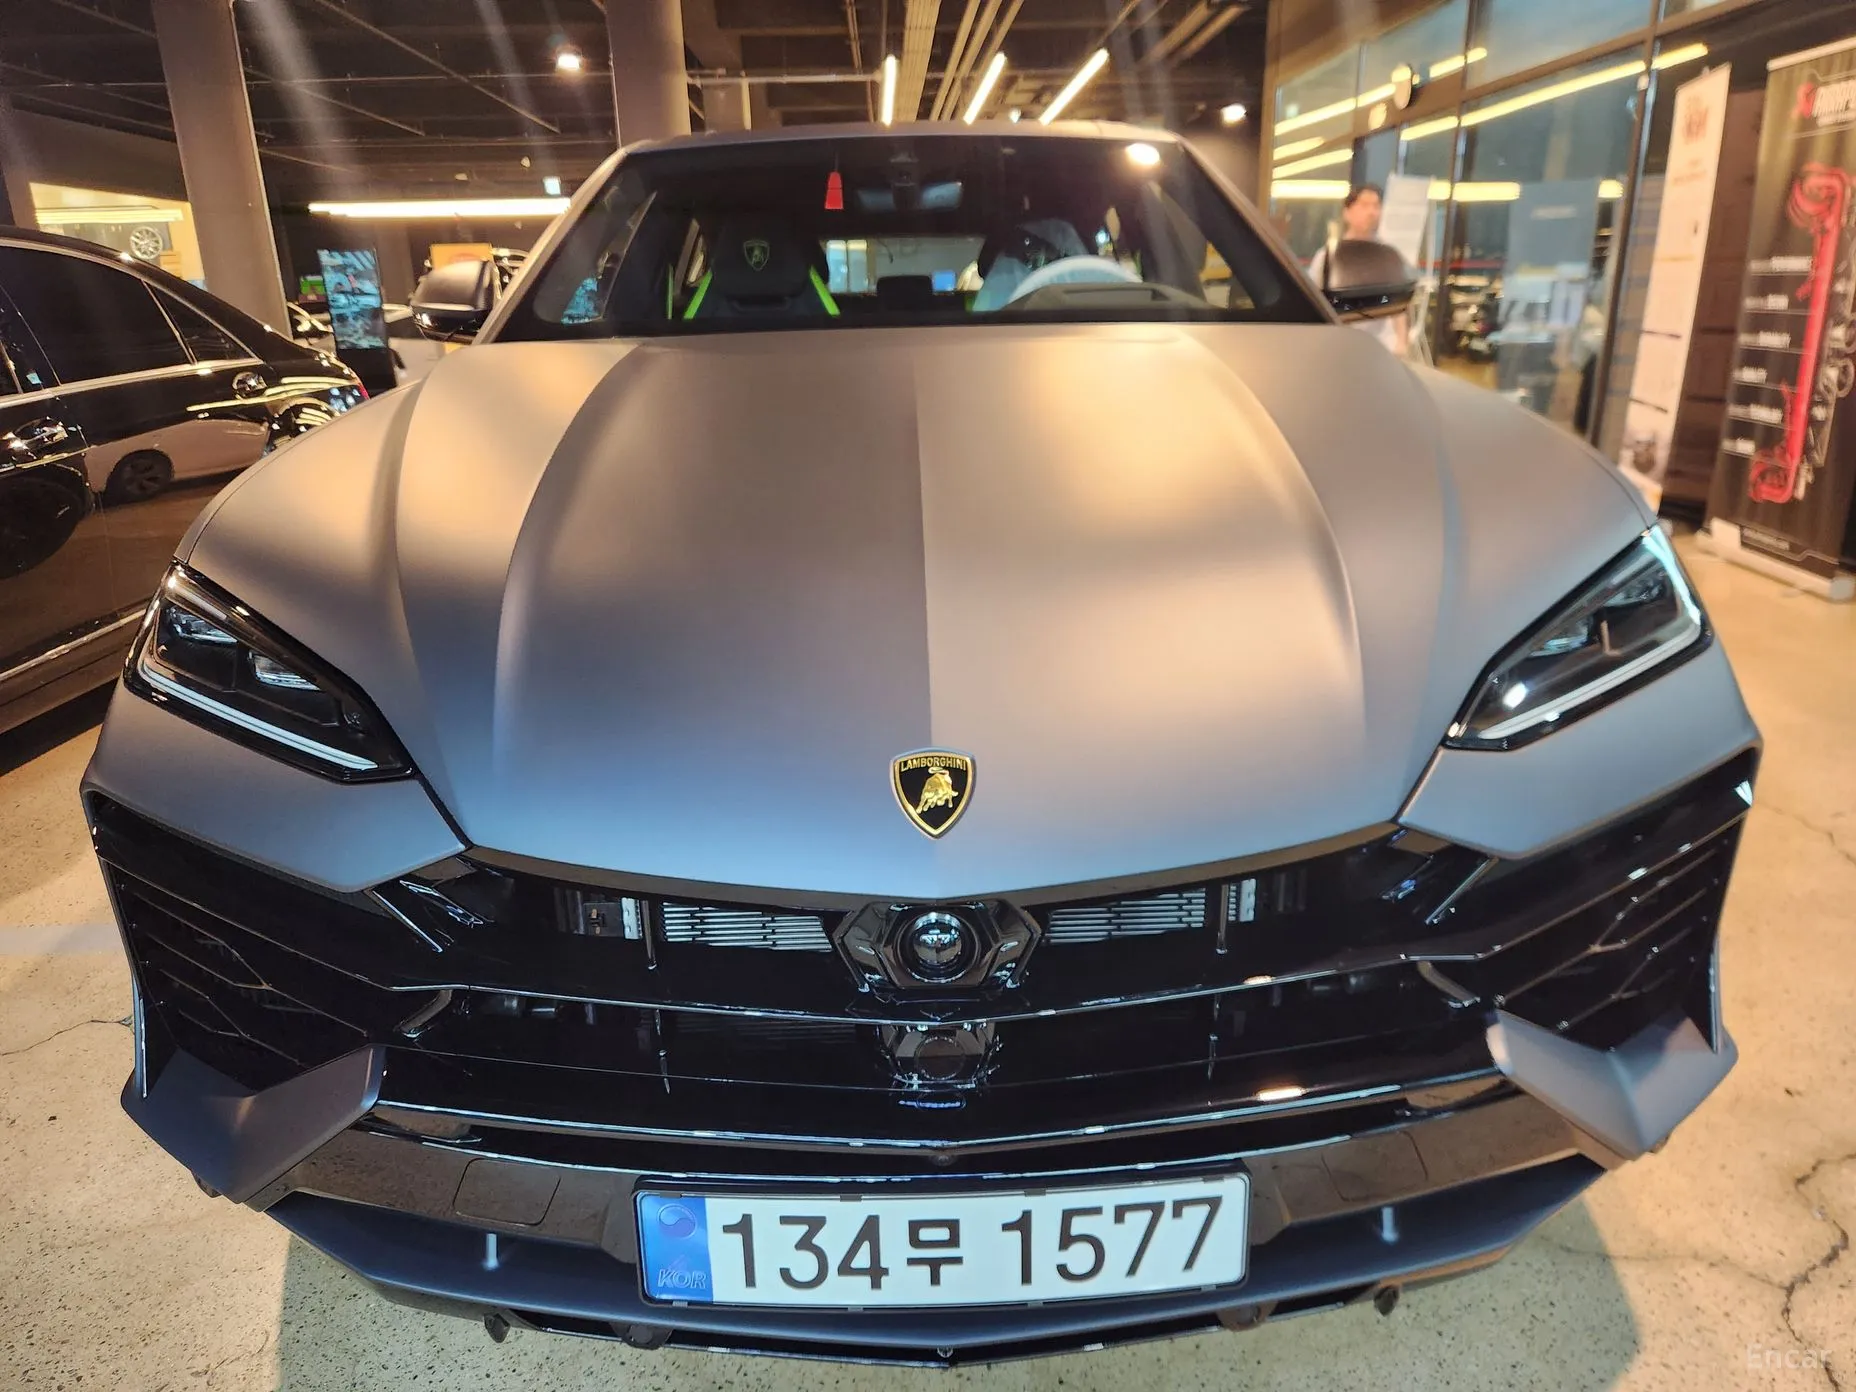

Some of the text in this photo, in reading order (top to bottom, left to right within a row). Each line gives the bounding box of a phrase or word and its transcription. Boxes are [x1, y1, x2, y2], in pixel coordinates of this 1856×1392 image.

[901, 757, 966, 772] LAMBORGHINI
[722, 1196, 1224, 1290] 134무 1577
[657, 1268, 706, 1289] KOR
